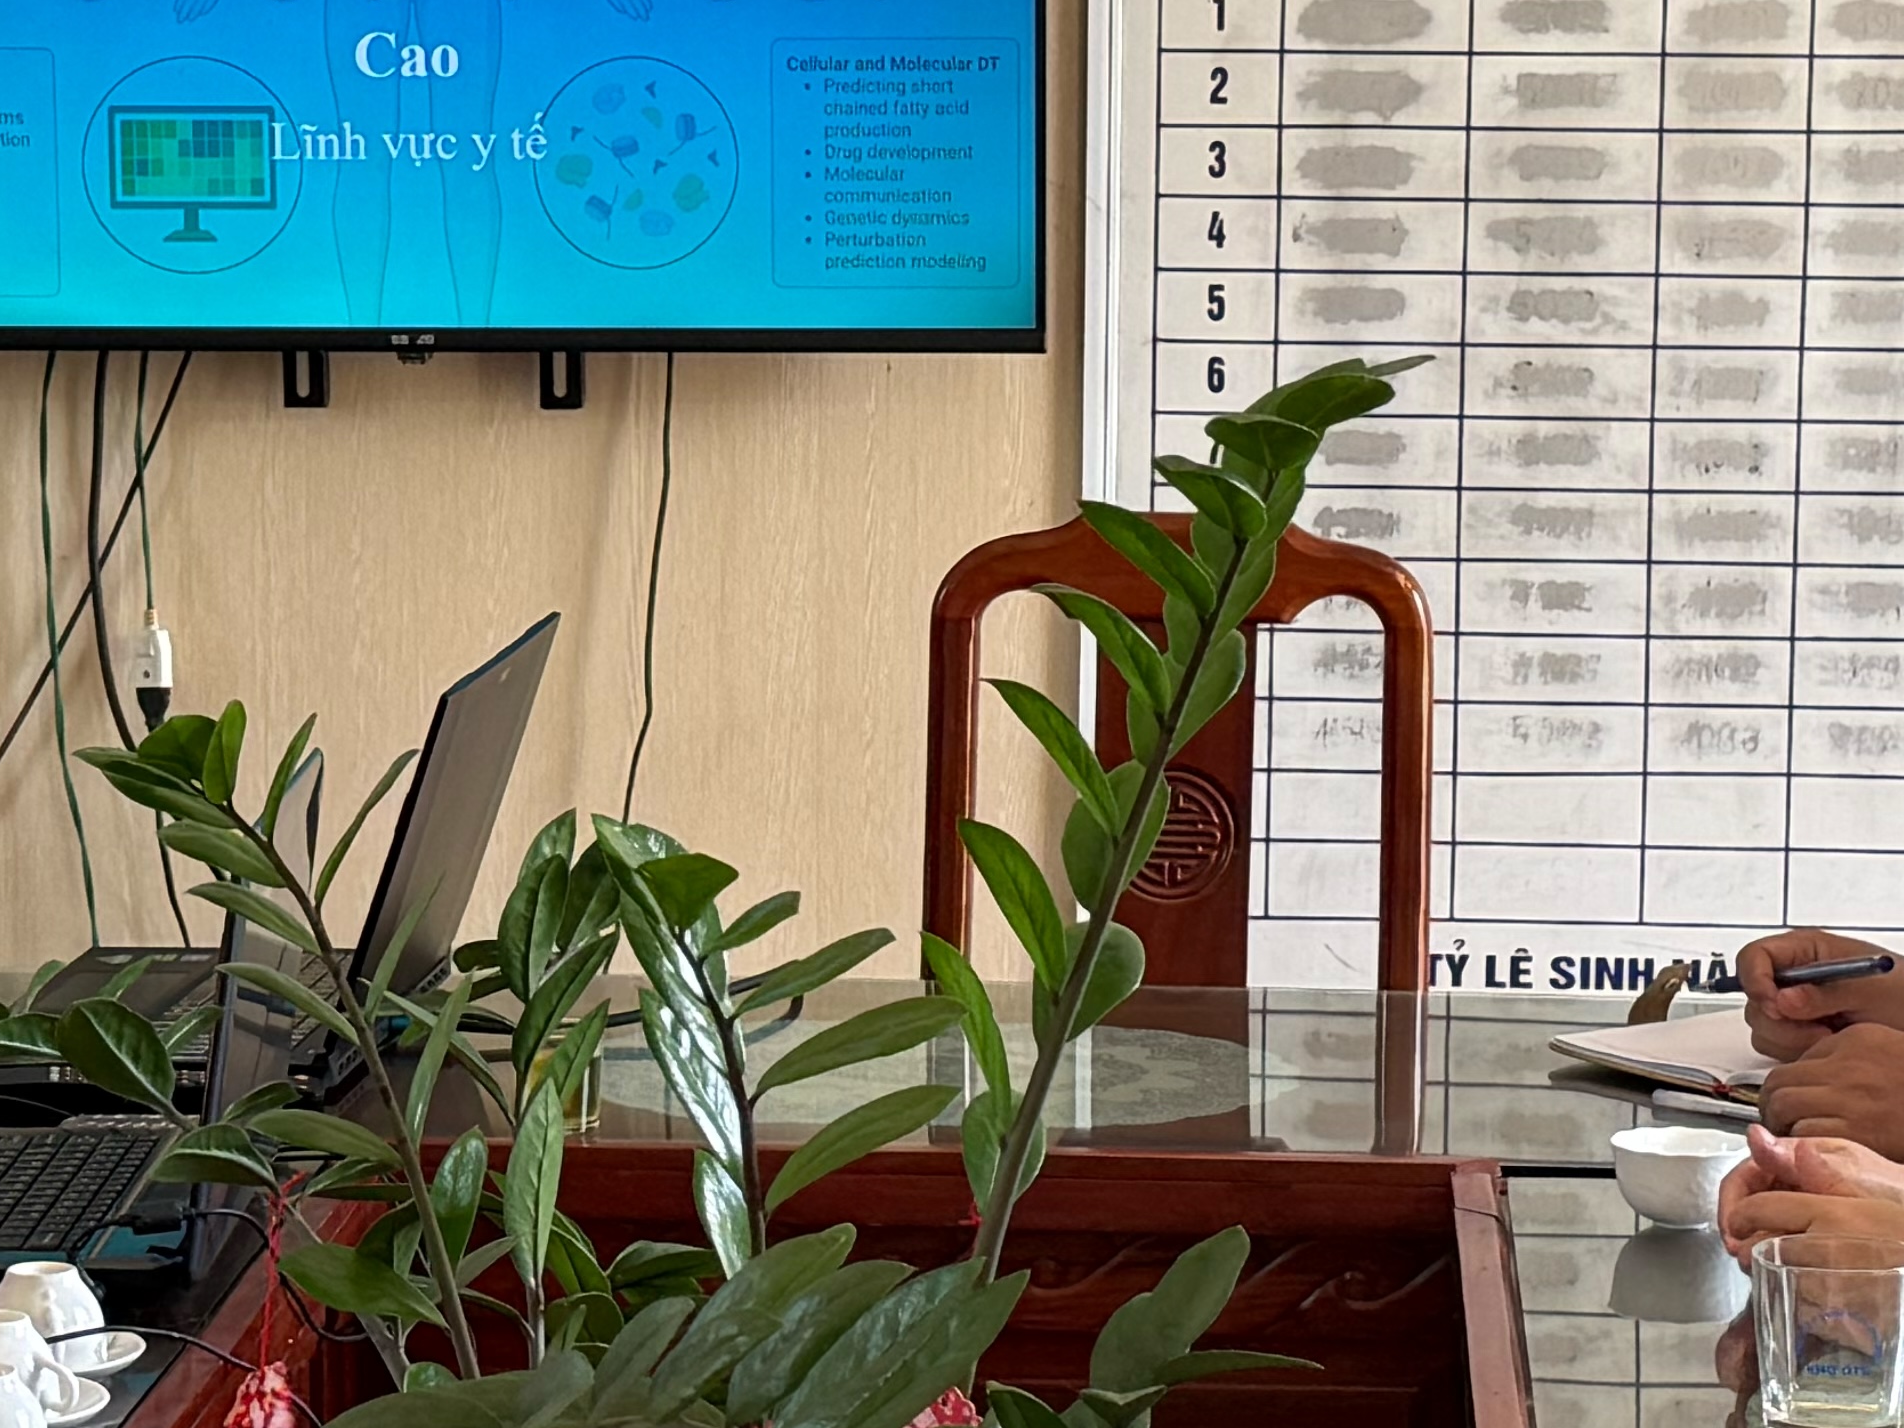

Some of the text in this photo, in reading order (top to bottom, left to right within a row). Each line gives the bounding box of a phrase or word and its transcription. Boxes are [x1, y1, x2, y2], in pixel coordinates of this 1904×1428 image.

[355, 30, 459, 79] Cao
[1208, 66, 1229, 106] 2
[271, 111, 548, 171] Lĩnh vực y tế
[824, 142, 974, 164] Drug development
[1207, 139, 1227, 180] 3
[824, 230, 927, 248] Perturbation
[1206, 212, 1227, 249] 4
[1206, 283, 1225, 323] 5
[1206, 356, 1226, 395] 6
[1428, 938, 1469, 987] TỶ
[1549, 956, 1654, 991] SINH
